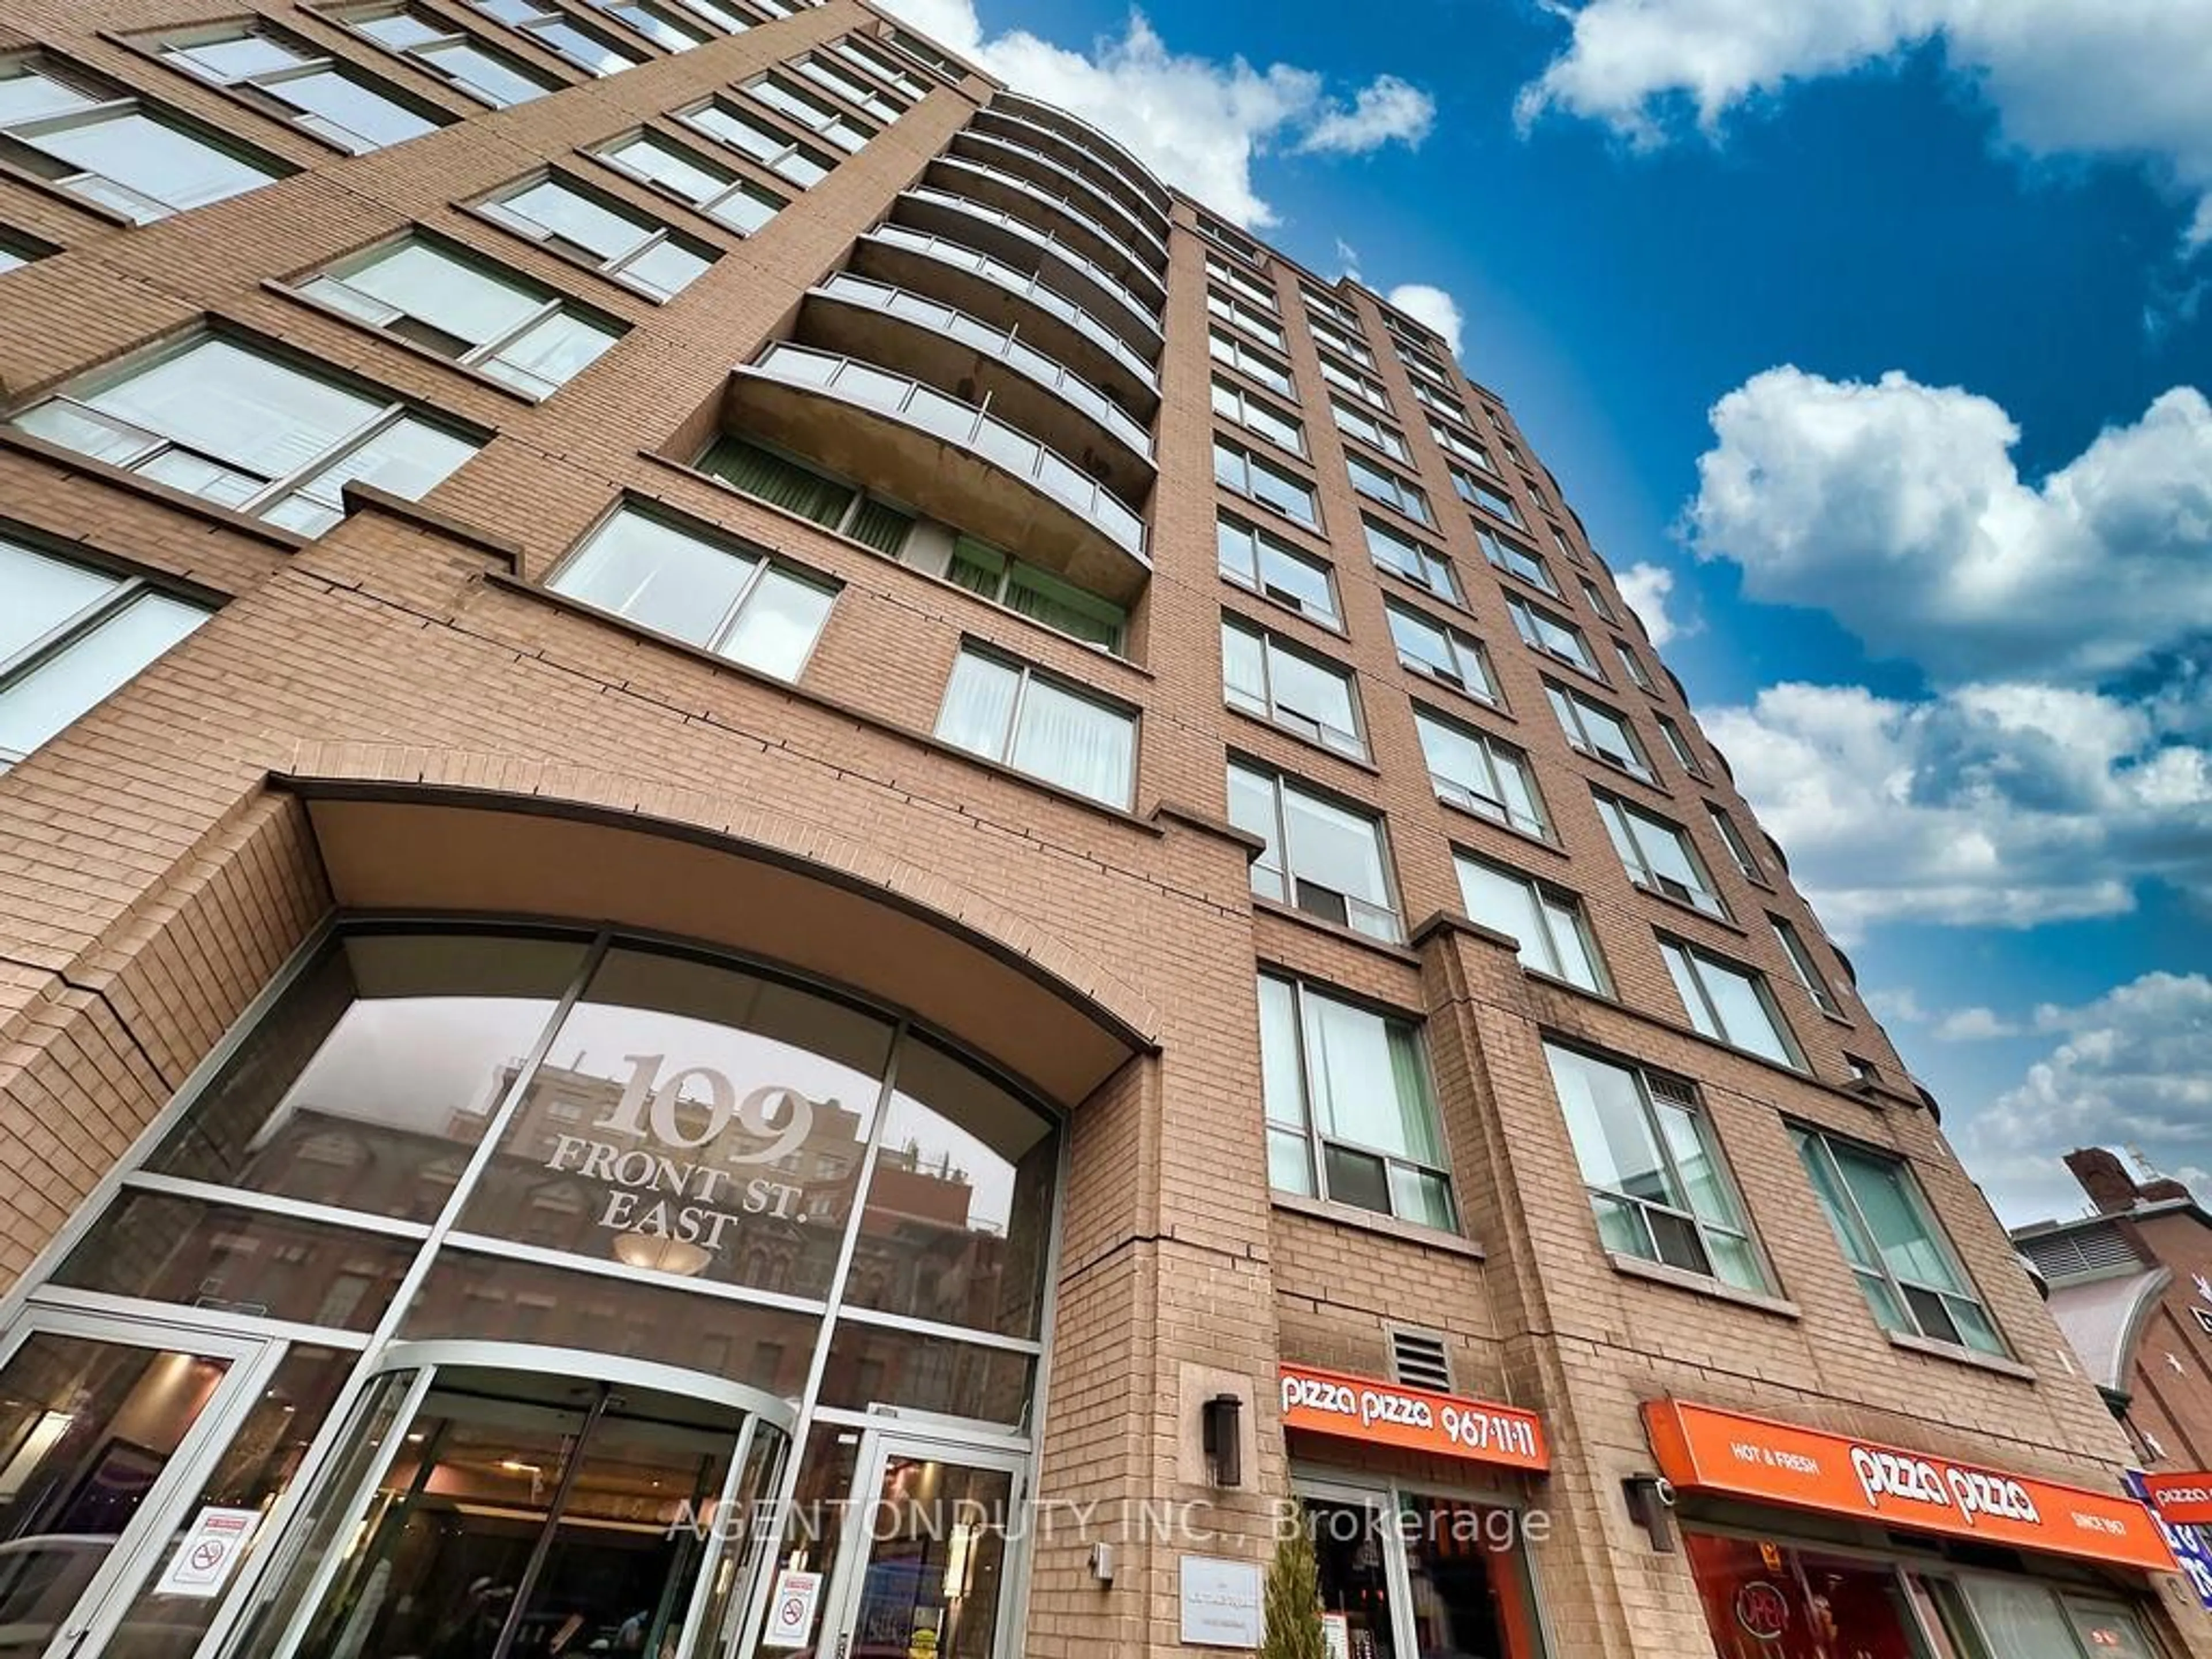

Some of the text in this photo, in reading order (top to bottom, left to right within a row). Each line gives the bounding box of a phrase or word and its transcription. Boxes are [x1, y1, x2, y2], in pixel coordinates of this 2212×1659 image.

[592, 1054, 813, 1164] 109
[545, 1133, 808, 1224] FRONT ST.
[598, 1190, 738, 1251] EAST
[1282, 1376, 1357, 1414] pizza
[1361, 1391, 1434, 1427] pizza
[1729, 1441, 1820, 1476] HOT & FRESH
[1850, 1445, 2043, 1527] pizza pizza
